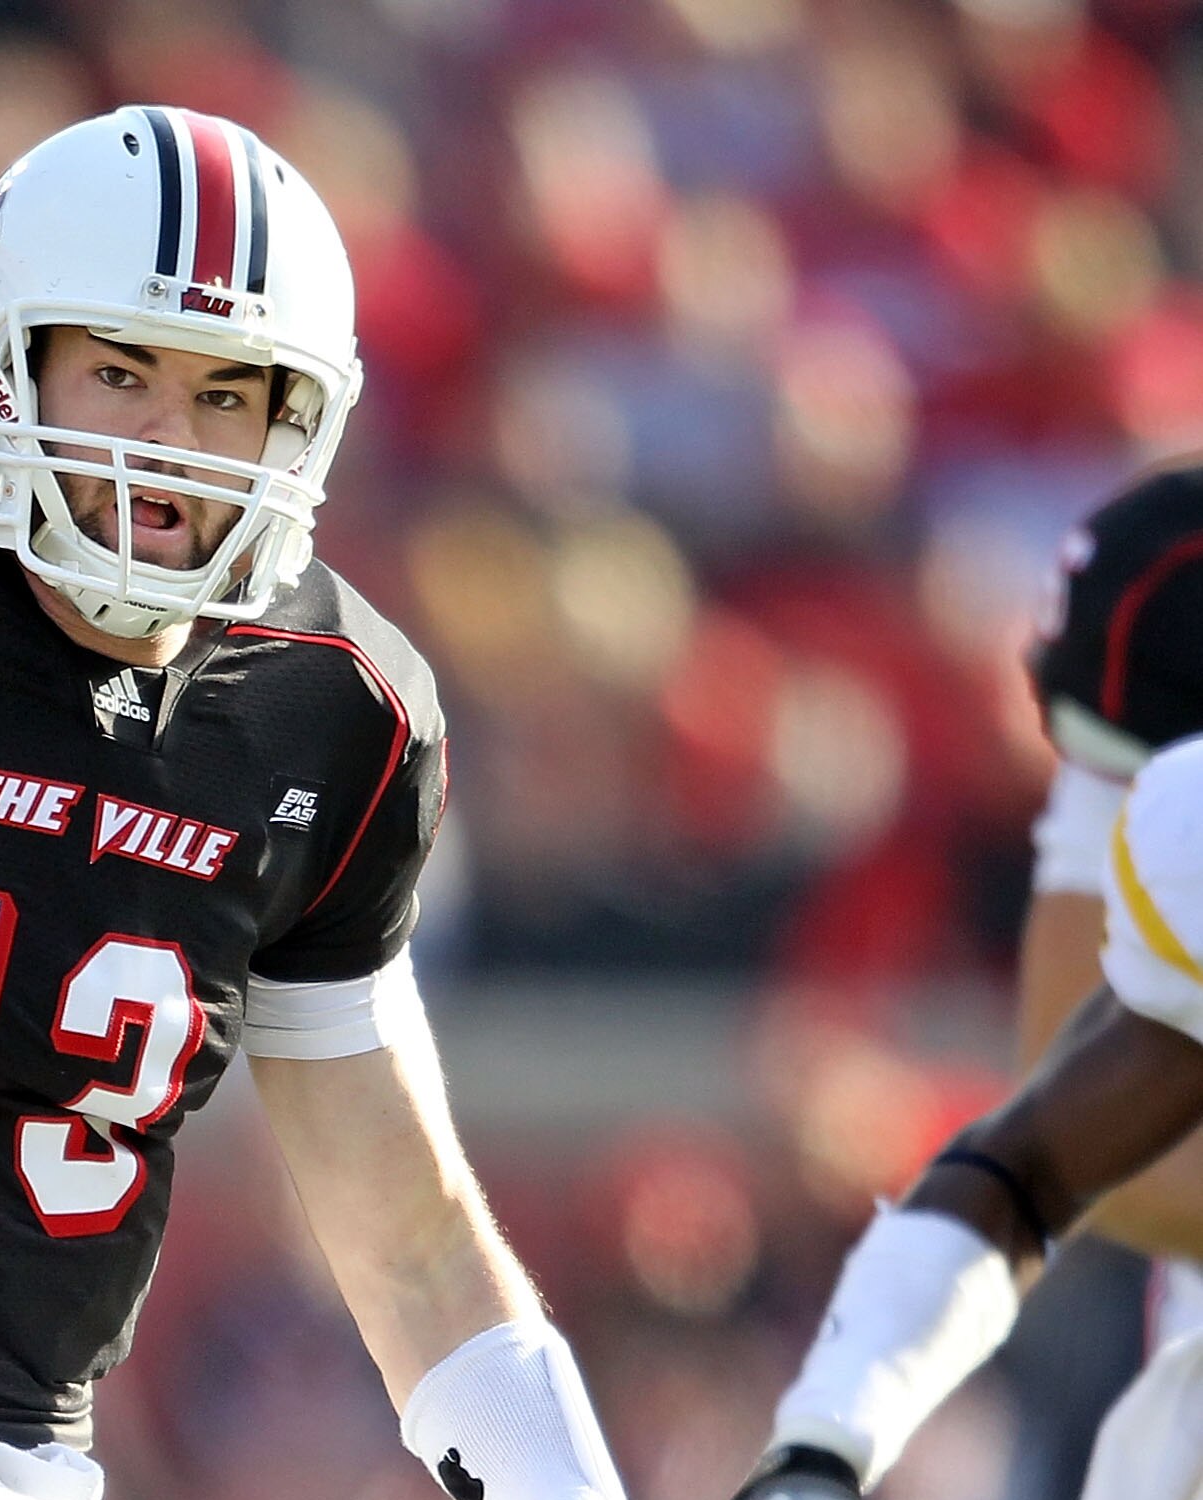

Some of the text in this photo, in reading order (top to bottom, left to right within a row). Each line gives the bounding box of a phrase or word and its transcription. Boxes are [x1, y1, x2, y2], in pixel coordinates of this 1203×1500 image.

[94, 693, 150, 722] adidas
[282, 787, 318, 807] BIG
[274, 802, 318, 822] EAST
[90, 793, 240, 882] VILLE
